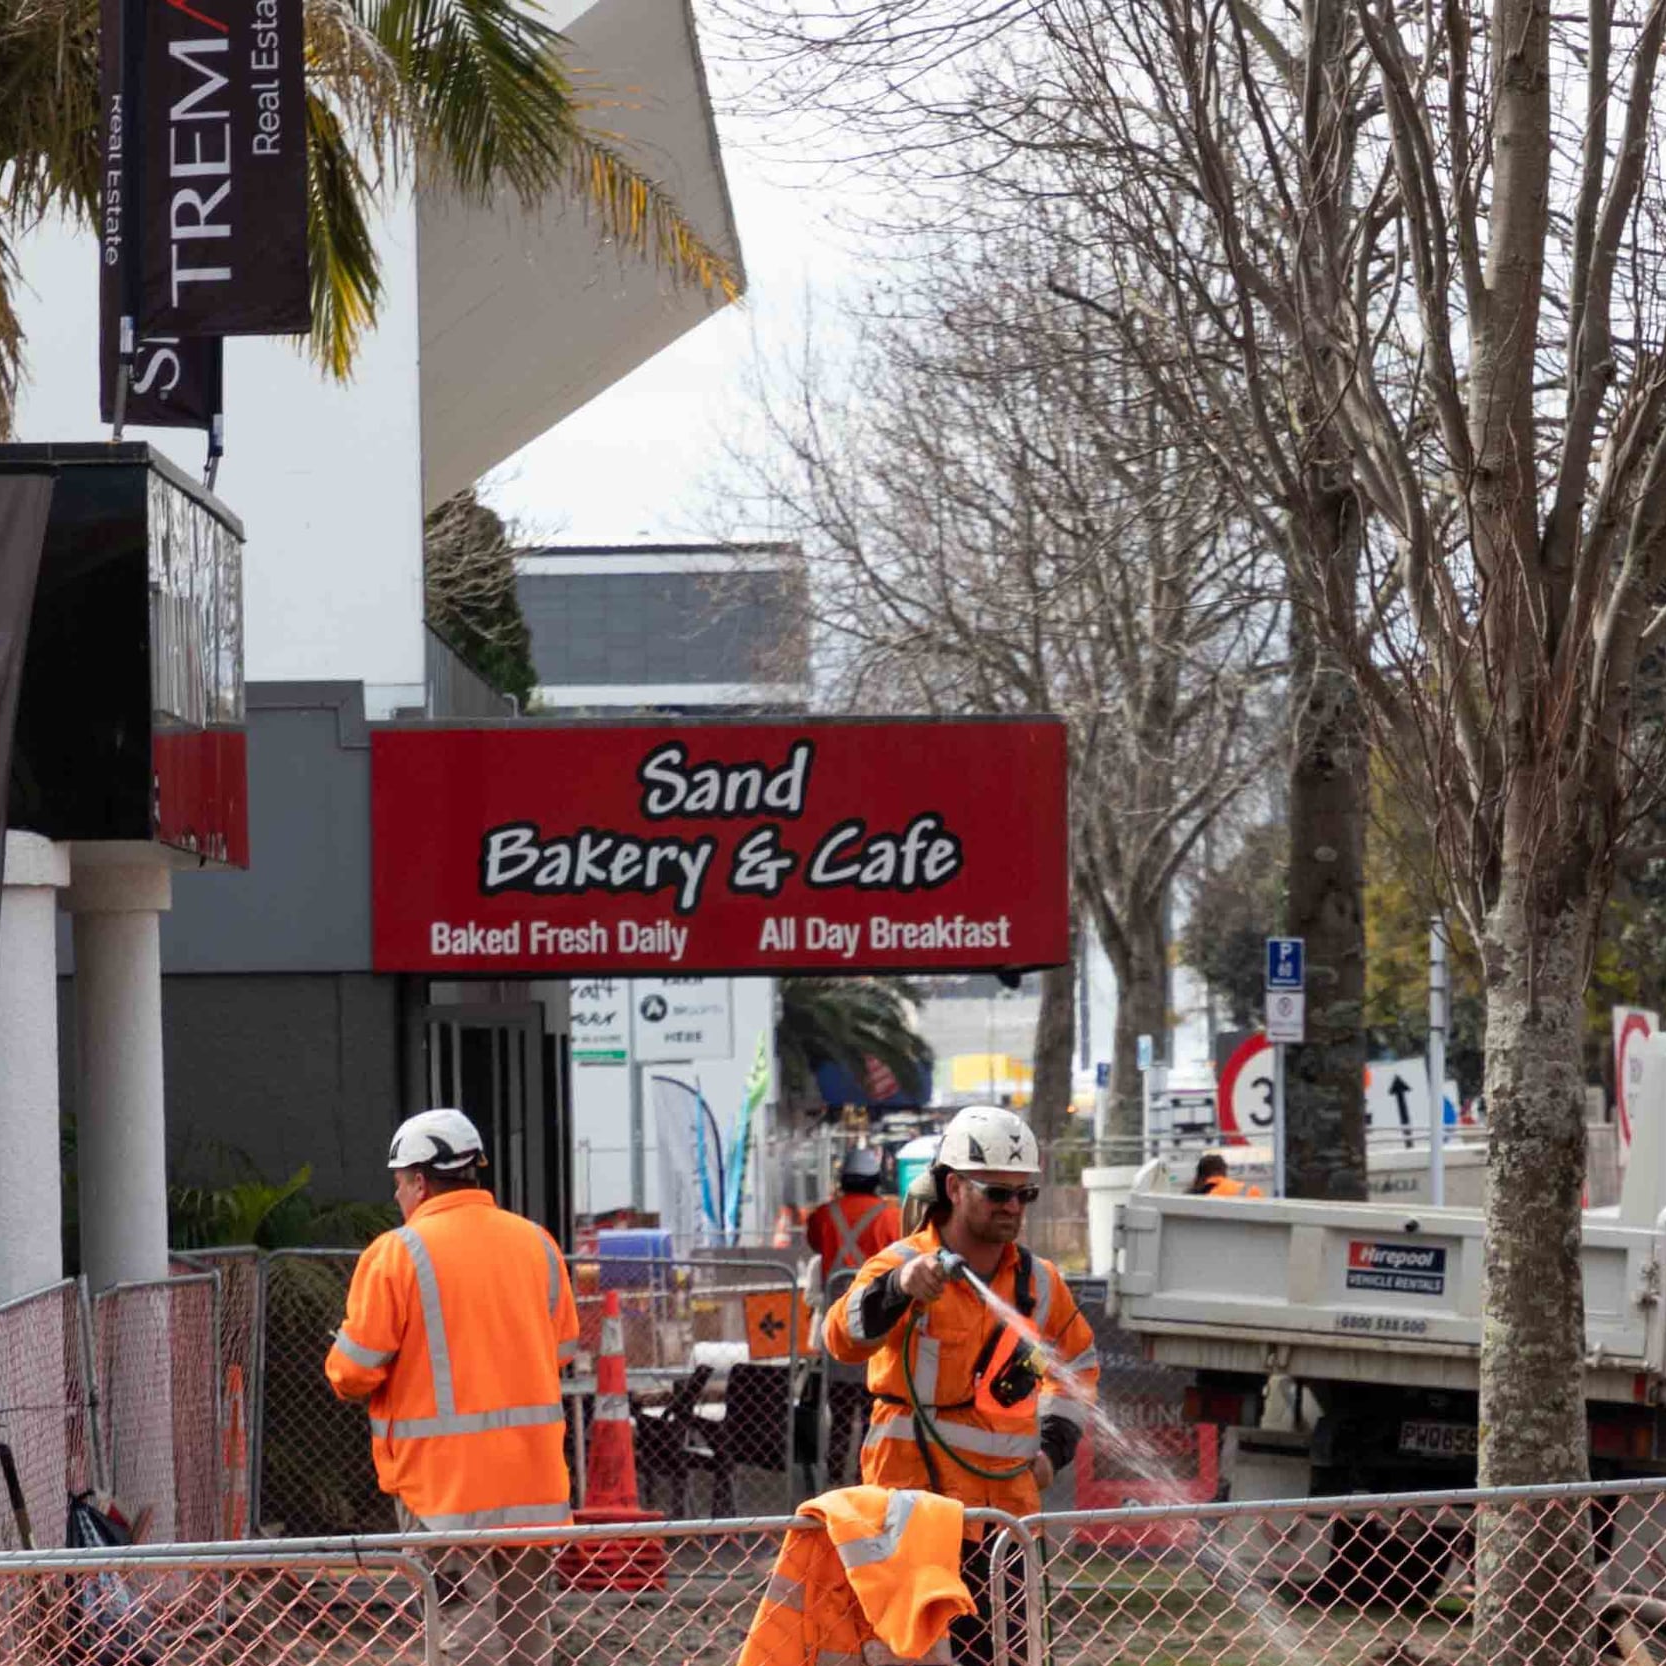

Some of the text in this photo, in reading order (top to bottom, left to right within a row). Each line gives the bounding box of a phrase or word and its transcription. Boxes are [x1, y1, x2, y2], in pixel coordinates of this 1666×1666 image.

[252, 80, 280, 155] Real
[644, 745, 809, 814] Sand
[485, 818, 958, 909] Bakery & Cafe
[431, 919, 687, 960] Baked Fresh Daily
[760, 915, 1010, 958] All Day Breakfast
[1360, 1246, 1434, 1268] Hirepool
[1349, 1273, 1442, 1292] VEHICLE RENTALS
